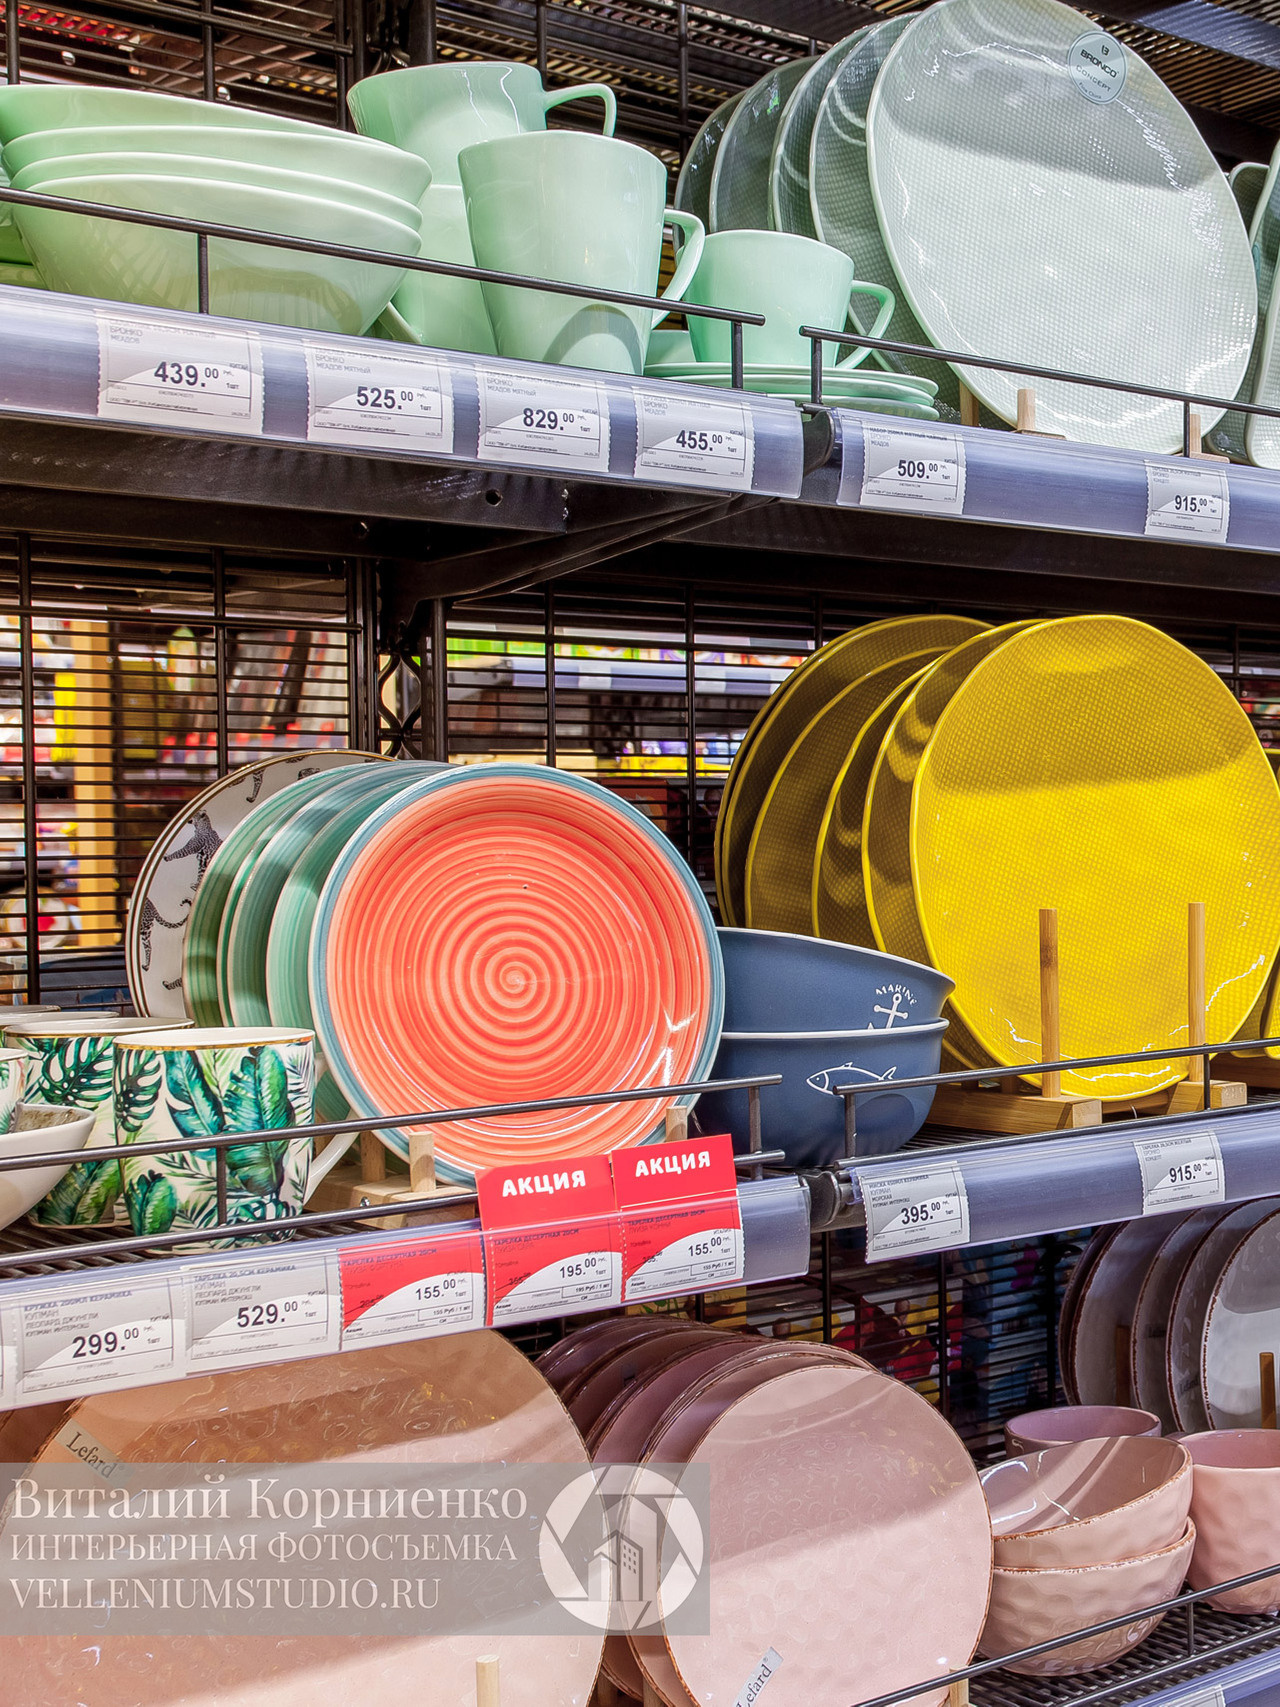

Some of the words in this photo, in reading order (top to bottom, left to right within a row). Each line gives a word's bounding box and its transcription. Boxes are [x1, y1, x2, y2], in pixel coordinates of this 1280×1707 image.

[1080, 49, 1117, 78] BRONCO
[1076, 65, 1111, 92] CONCEPT
[875, 984, 918, 1006] MARINE
[635, 1150, 711, 1178] АКЦИЯ
[502, 1170, 586, 1198] АКЦИЯ
[901, 1202, 941, 1225] 395.00
[560, 1257, 596, 1278] 195.00
[416, 1278, 456, 1300] 155.00
[237, 1301, 298, 1328] 529.00
[72, 1327, 140, 1358] 299.00
[66, 1432, 118, 1478] Lefard
